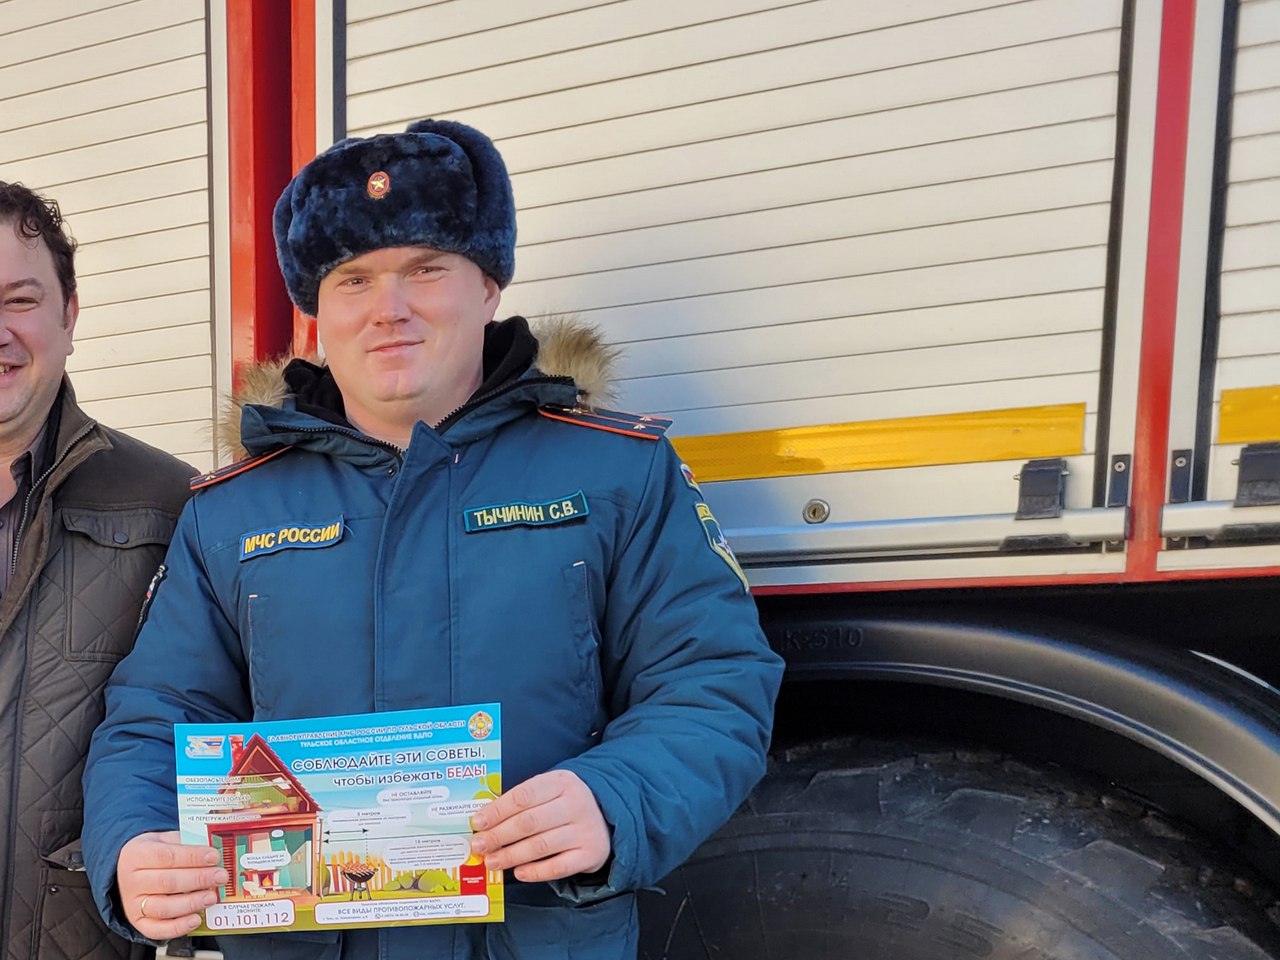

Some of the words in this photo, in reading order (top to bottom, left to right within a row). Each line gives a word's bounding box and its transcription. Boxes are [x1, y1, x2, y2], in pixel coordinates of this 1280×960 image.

[474, 506, 543, 527] ТЫЧИНИН
[549, 501, 578, 520] С.В.
[244, 534, 275, 554] МЧС
[277, 522, 340, 544] РОССИИ
[356, 727, 386, 736] РОССИИ
[293, 753, 391, 771] СОБЛЮДАЙТЕ
[396, 751, 421, 763] ЭТИ
[426, 746, 485, 760] СОВЕТЫ,
[334, 776, 374, 787] чтобы
[378, 771, 442, 784] избежать
[447, 764, 486, 778] БЕДЫ
[374, 903, 442, 913] ПРОТИВОПОЖАРНЫХ
